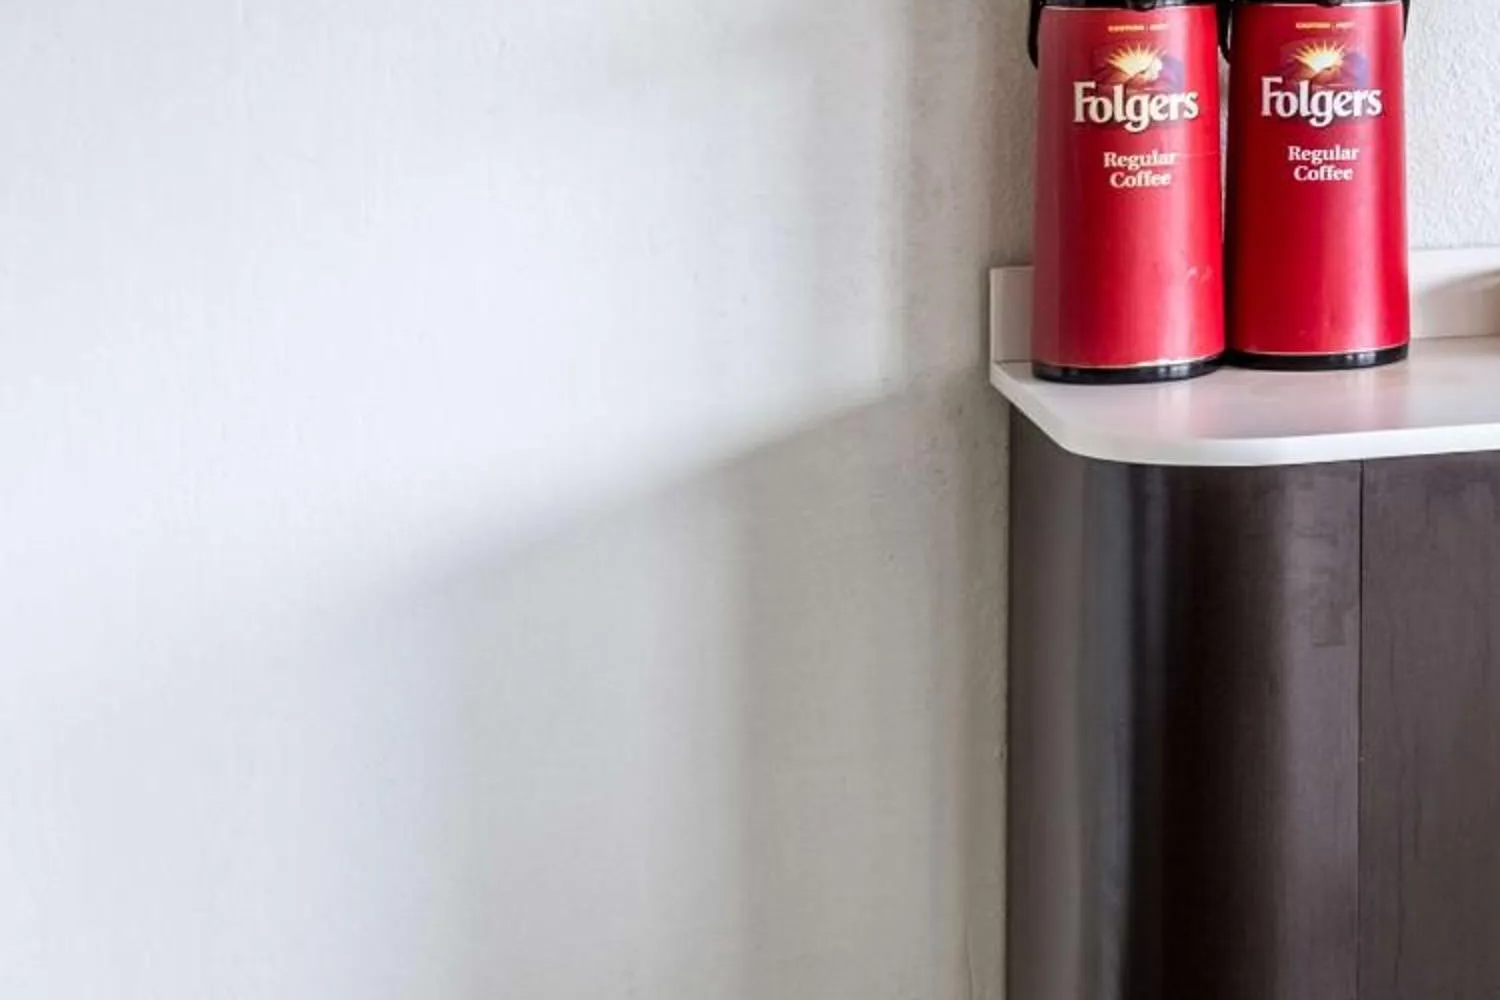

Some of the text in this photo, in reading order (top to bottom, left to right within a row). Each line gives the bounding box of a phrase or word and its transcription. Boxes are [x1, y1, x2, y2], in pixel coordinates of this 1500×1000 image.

[1073, 81, 1199, 132] Folgers
[1260, 76, 1383, 127] Folgers
[1103, 151, 1177, 170] Regular
[1288, 145, 1360, 163] Regular
[1109, 171, 1172, 188] Coffee
[1293, 165, 1354, 182] Coffee
